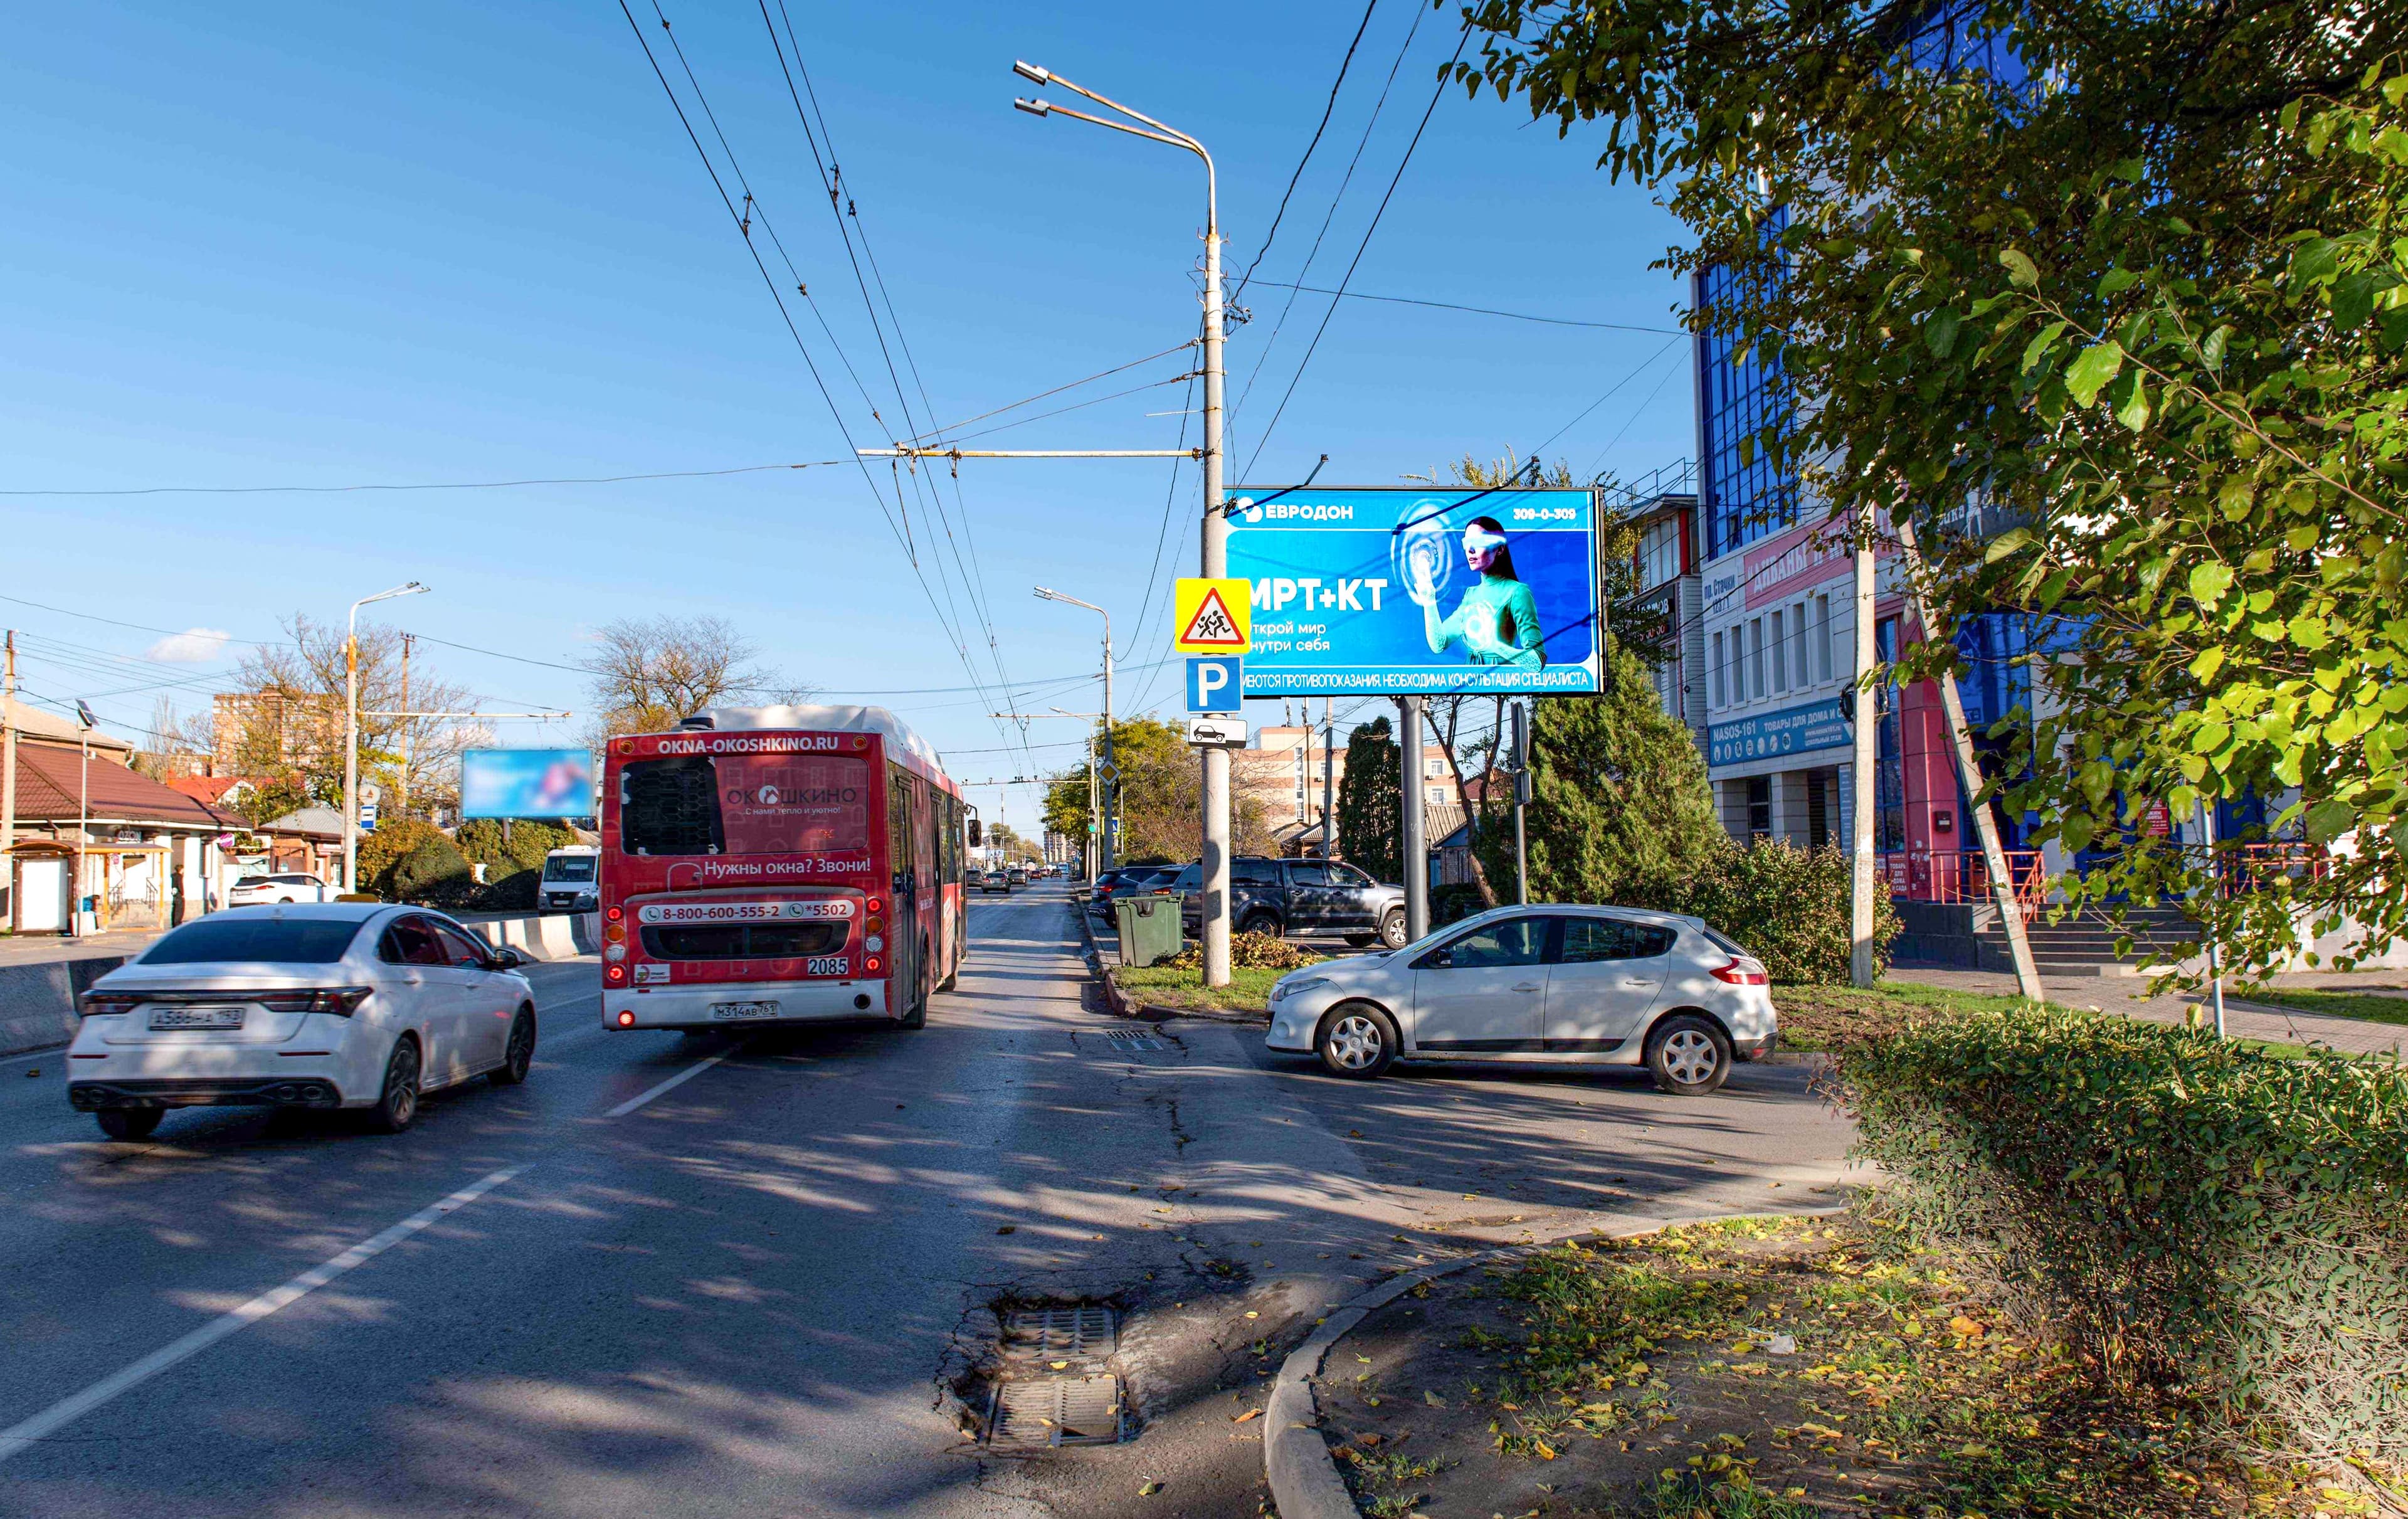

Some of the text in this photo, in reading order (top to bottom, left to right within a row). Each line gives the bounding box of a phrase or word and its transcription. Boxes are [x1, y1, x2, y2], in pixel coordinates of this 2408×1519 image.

[1265, 504, 1353, 521] ЕВРОДОН
[1513, 508, 1576, 520] 309-0-309
[1714, 574, 1735, 596] Стачки
[1250, 578, 1388, 611] МРТ+КТ
[1250, 621, 1326, 637] ткрой мир
[1250, 638, 1330, 654] нутри себя
[1198, 664, 1228, 706] P
[1282, 674, 1381, 688] ПРОТИВОПОКАЗАНИЯ.
[1383, 673, 1446, 689] НЕОБХОДИМА
[1448, 672, 1520, 689] КОНСУЛЬТАЦИЯ
[1521, 672, 1588, 687] СПЕЦИАЛИСТА
[1764, 720, 1790, 733] ТОВАРЫ
[1792, 714, 1806, 729] ДЛЯ
[1807, 709, 1829, 726] ДОМА
[1830, 708, 1836, 719] И
[1713, 721, 1756, 742] NASOS-161
[658, 736, 839, 754] OKNA-OKOSHKINO.RU
[812, 806, 841, 815] уютно!
[118, 830, 142, 840] OZON
[704, 857, 871, 879] Нужны окна? Звони!
[663, 906, 779, 919] 8-800-600-555-2
[808, 958, 848, 975] 2085
